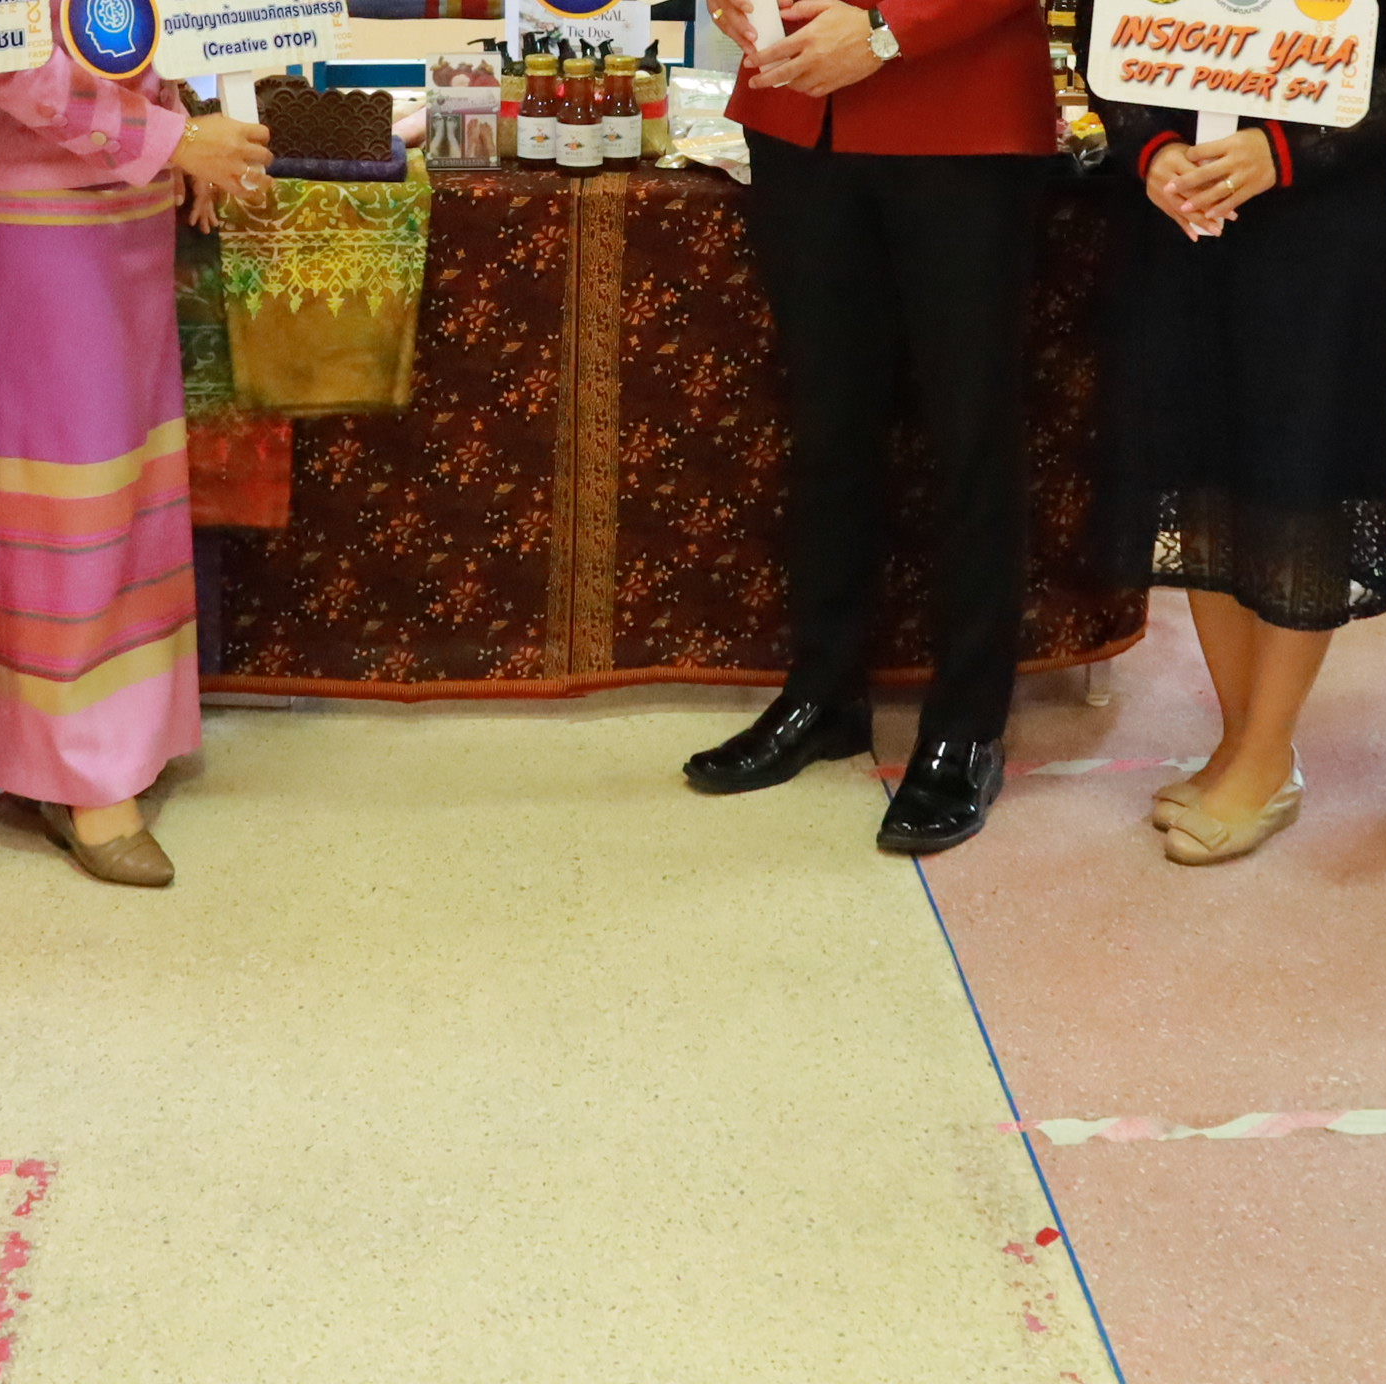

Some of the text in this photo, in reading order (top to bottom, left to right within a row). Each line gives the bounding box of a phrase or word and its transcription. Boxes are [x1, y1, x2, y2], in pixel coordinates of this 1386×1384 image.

[203, 31, 317, 59] (Creative OTOP)
[566, 26, 611, 42] Tie Dye
[1111, 14, 1357, 74] INSIGHT YALA
[1120, 58, 1185, 86] SOFT
[1191, 65, 1279, 101] POWER
